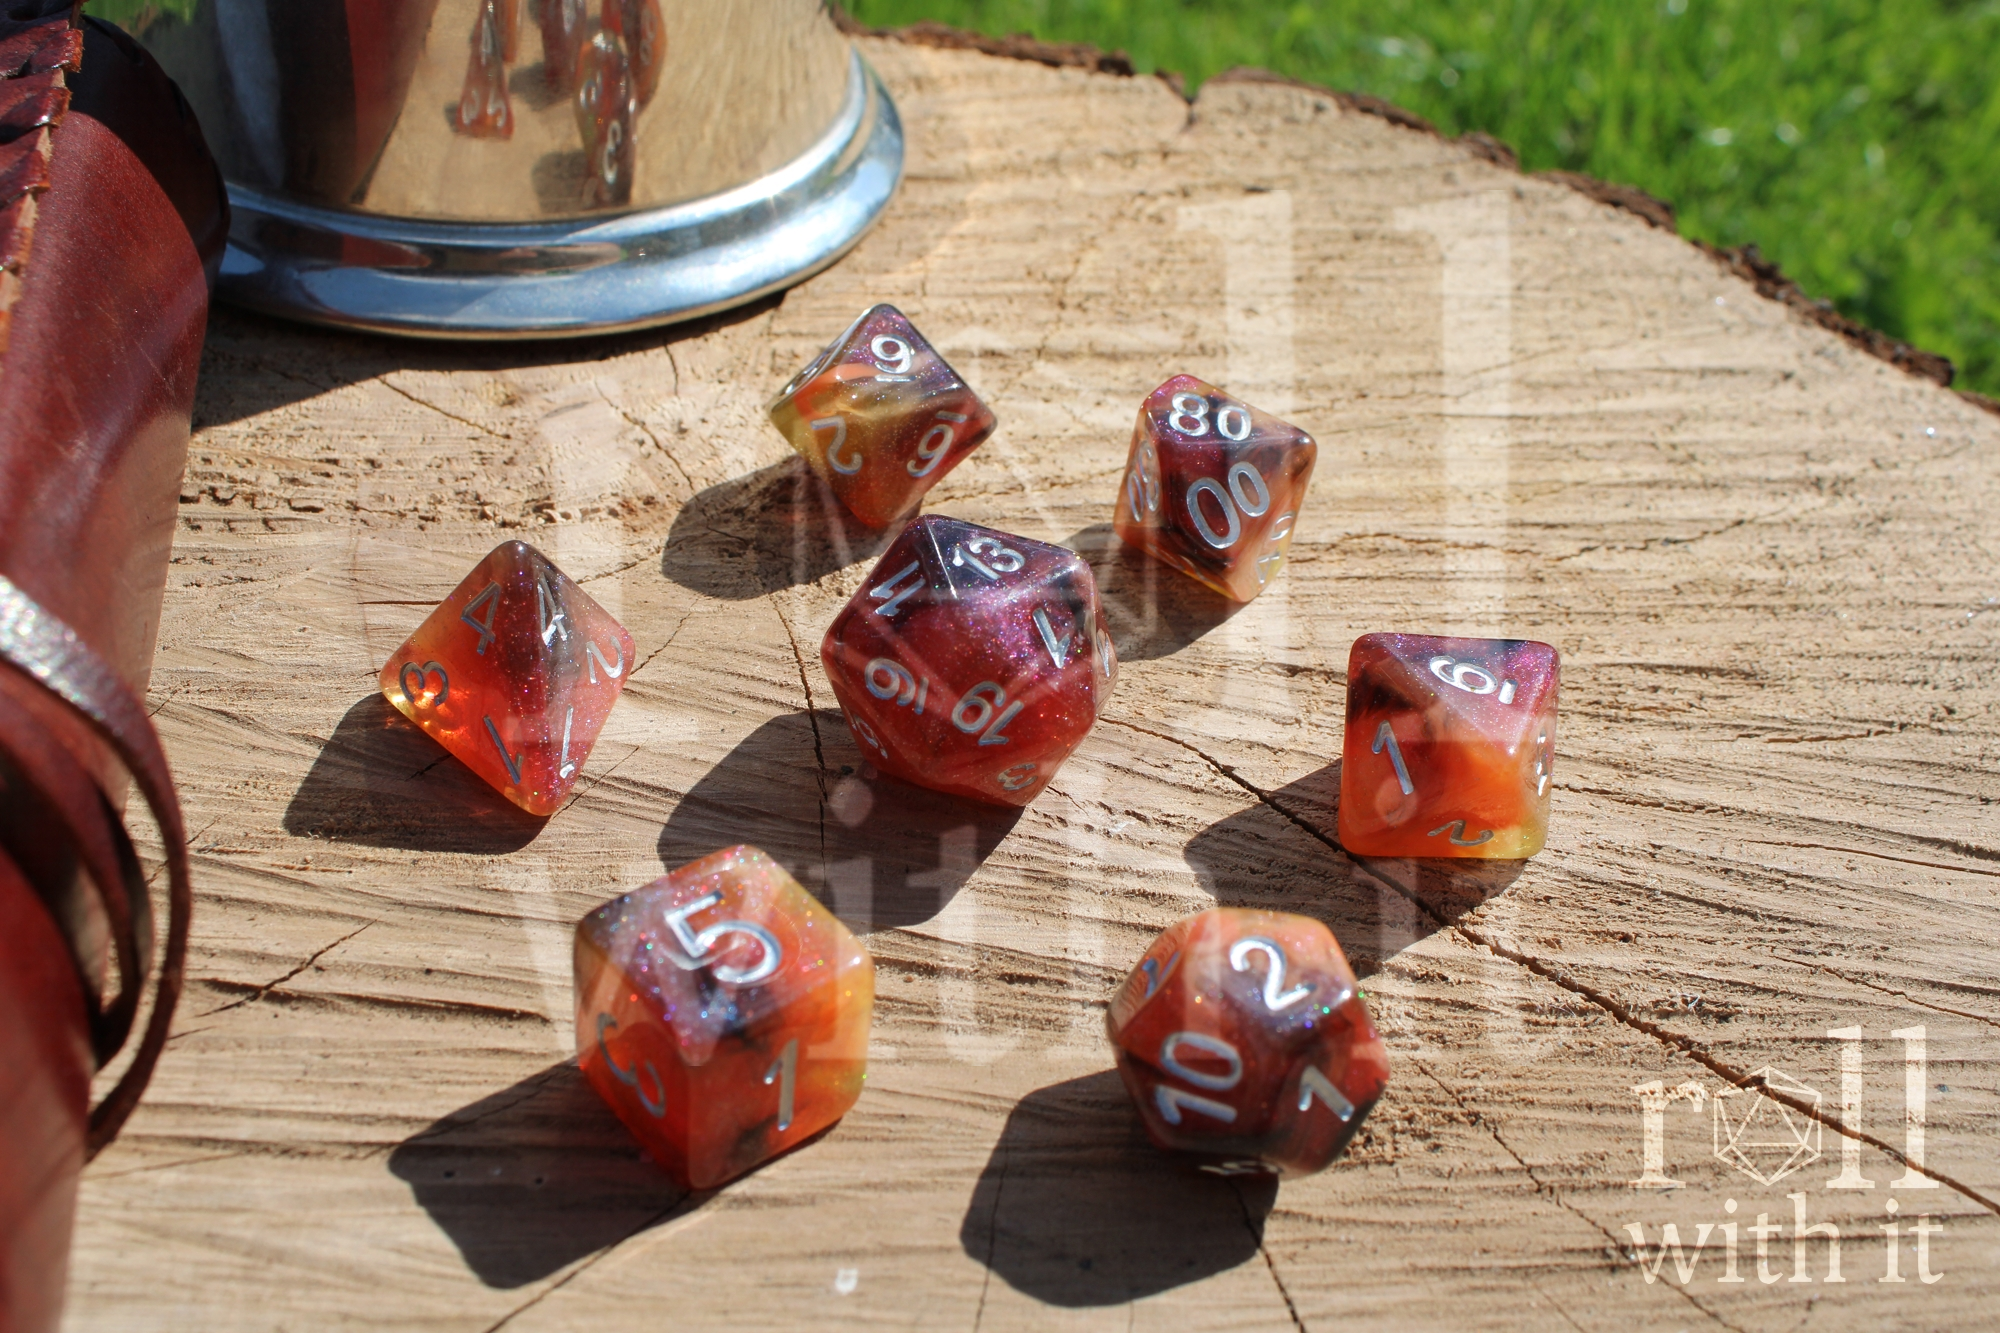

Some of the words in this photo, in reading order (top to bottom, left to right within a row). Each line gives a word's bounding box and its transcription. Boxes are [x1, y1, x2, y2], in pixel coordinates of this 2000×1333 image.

[871, 333, 918, 383] 9
[810, 415, 863, 475] 2
[1169, 391, 1252, 441] 80
[1186, 461, 1270, 549] 00
[869, 560, 926, 617] 11
[953, 537, 1026, 580] 13
[460, 580, 500, 655] 4
[536, 572, 568, 646] 4
[400, 660, 449, 707] 3
[586, 635, 625, 684] 2
[483, 714, 524, 785] 1
[560, 704, 575, 779] 1
[1372, 719, 1414, 795] 1
[664, 890, 783, 983] 5
[1229, 935, 1318, 1012] 2
[763, 1037, 798, 1132] 1
[1154, 1031, 1243, 1126] 10
[1298, 1064, 1355, 1122] 1
